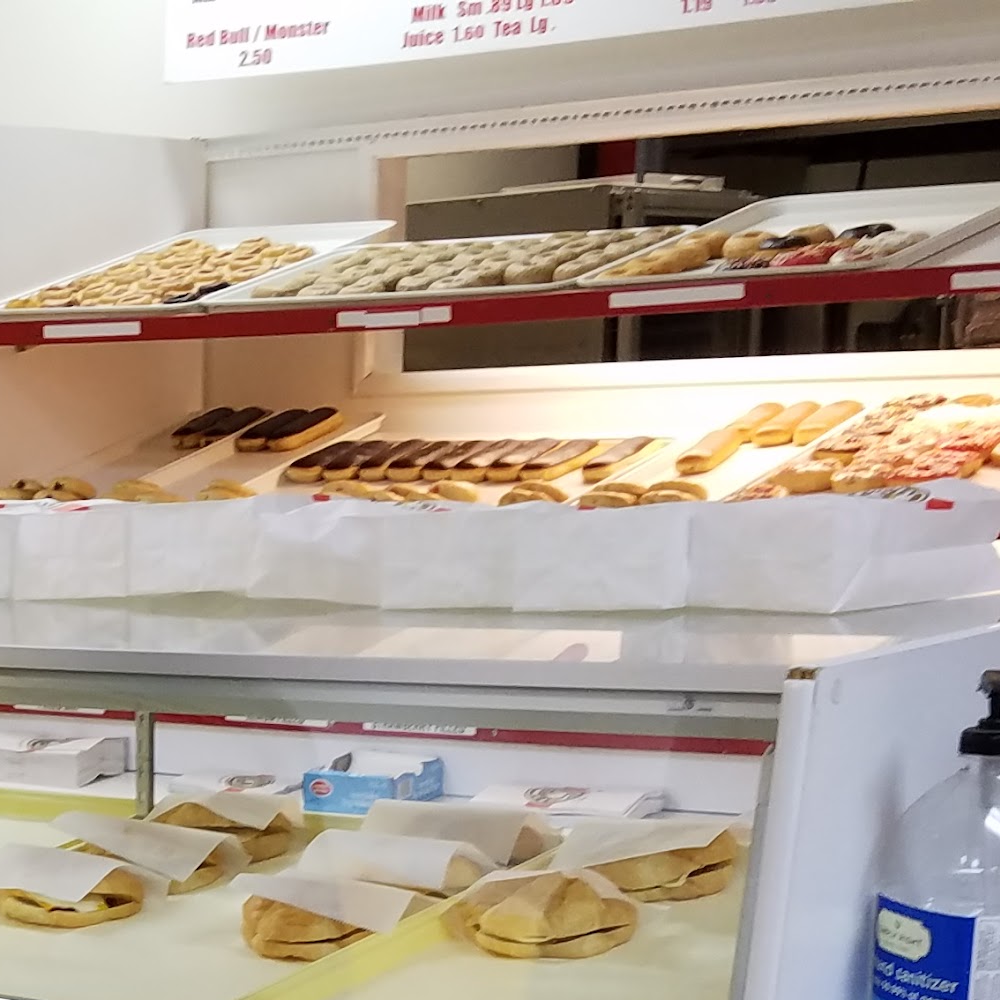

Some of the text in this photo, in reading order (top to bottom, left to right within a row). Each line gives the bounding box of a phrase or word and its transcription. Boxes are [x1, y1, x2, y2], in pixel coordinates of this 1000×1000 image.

[411, 5, 446, 23] Milk
[457, 2, 482, 17] Sm
[186, 30, 217, 49] Red
[219, 27, 250, 46] Bull
[264, 21, 330, 41] Monster
[400, 30, 444, 48] Juice
[452, 27, 484, 43] 1.60
[494, 20, 521, 38] Tea
[238, 48, 273, 67] 2.50
